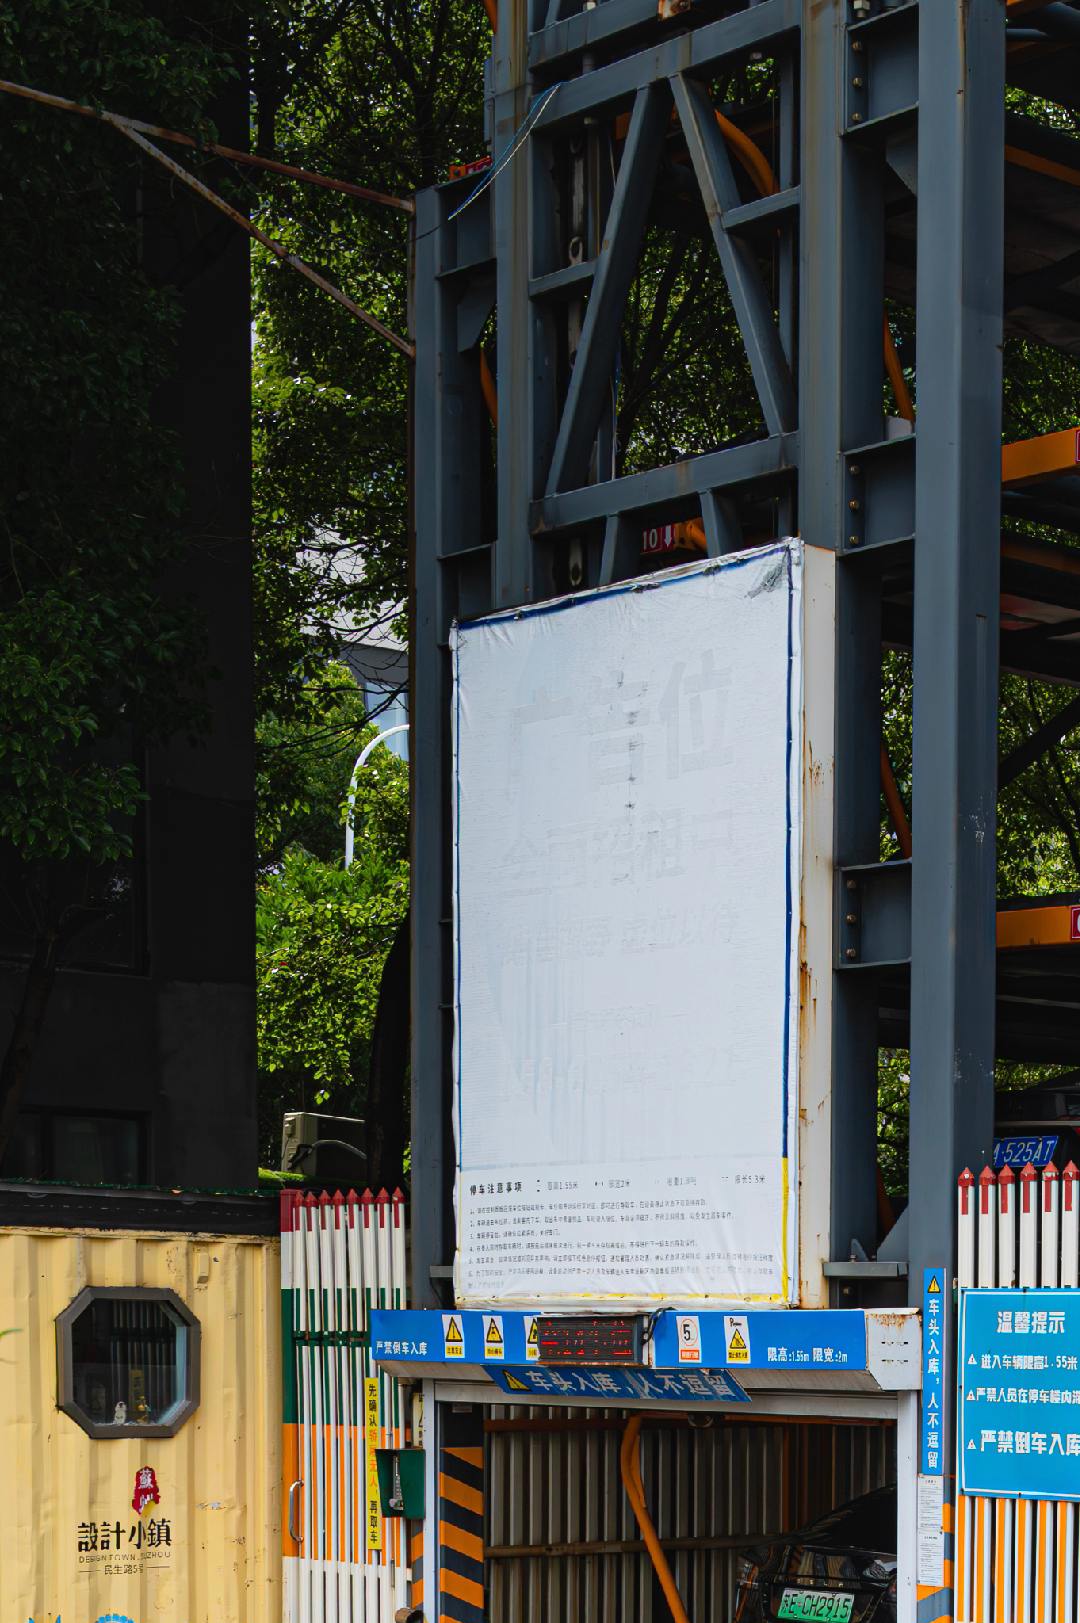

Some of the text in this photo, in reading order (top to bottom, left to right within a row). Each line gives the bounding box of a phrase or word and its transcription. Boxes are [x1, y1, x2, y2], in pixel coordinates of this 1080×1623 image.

[642, 528, 658, 550] 10
[470, 1182, 522, 1196] 停车注意事项
[683, 1323, 691, 1341] 5
[996, 1310, 1066, 1334] 温馨提示
[375, 1341, 428, 1357] 严禁倒车入库
[927, 1298, 941, 1470] 车头入库，人不逗留
[78, 1518, 172, 1552] 設計小鎮
